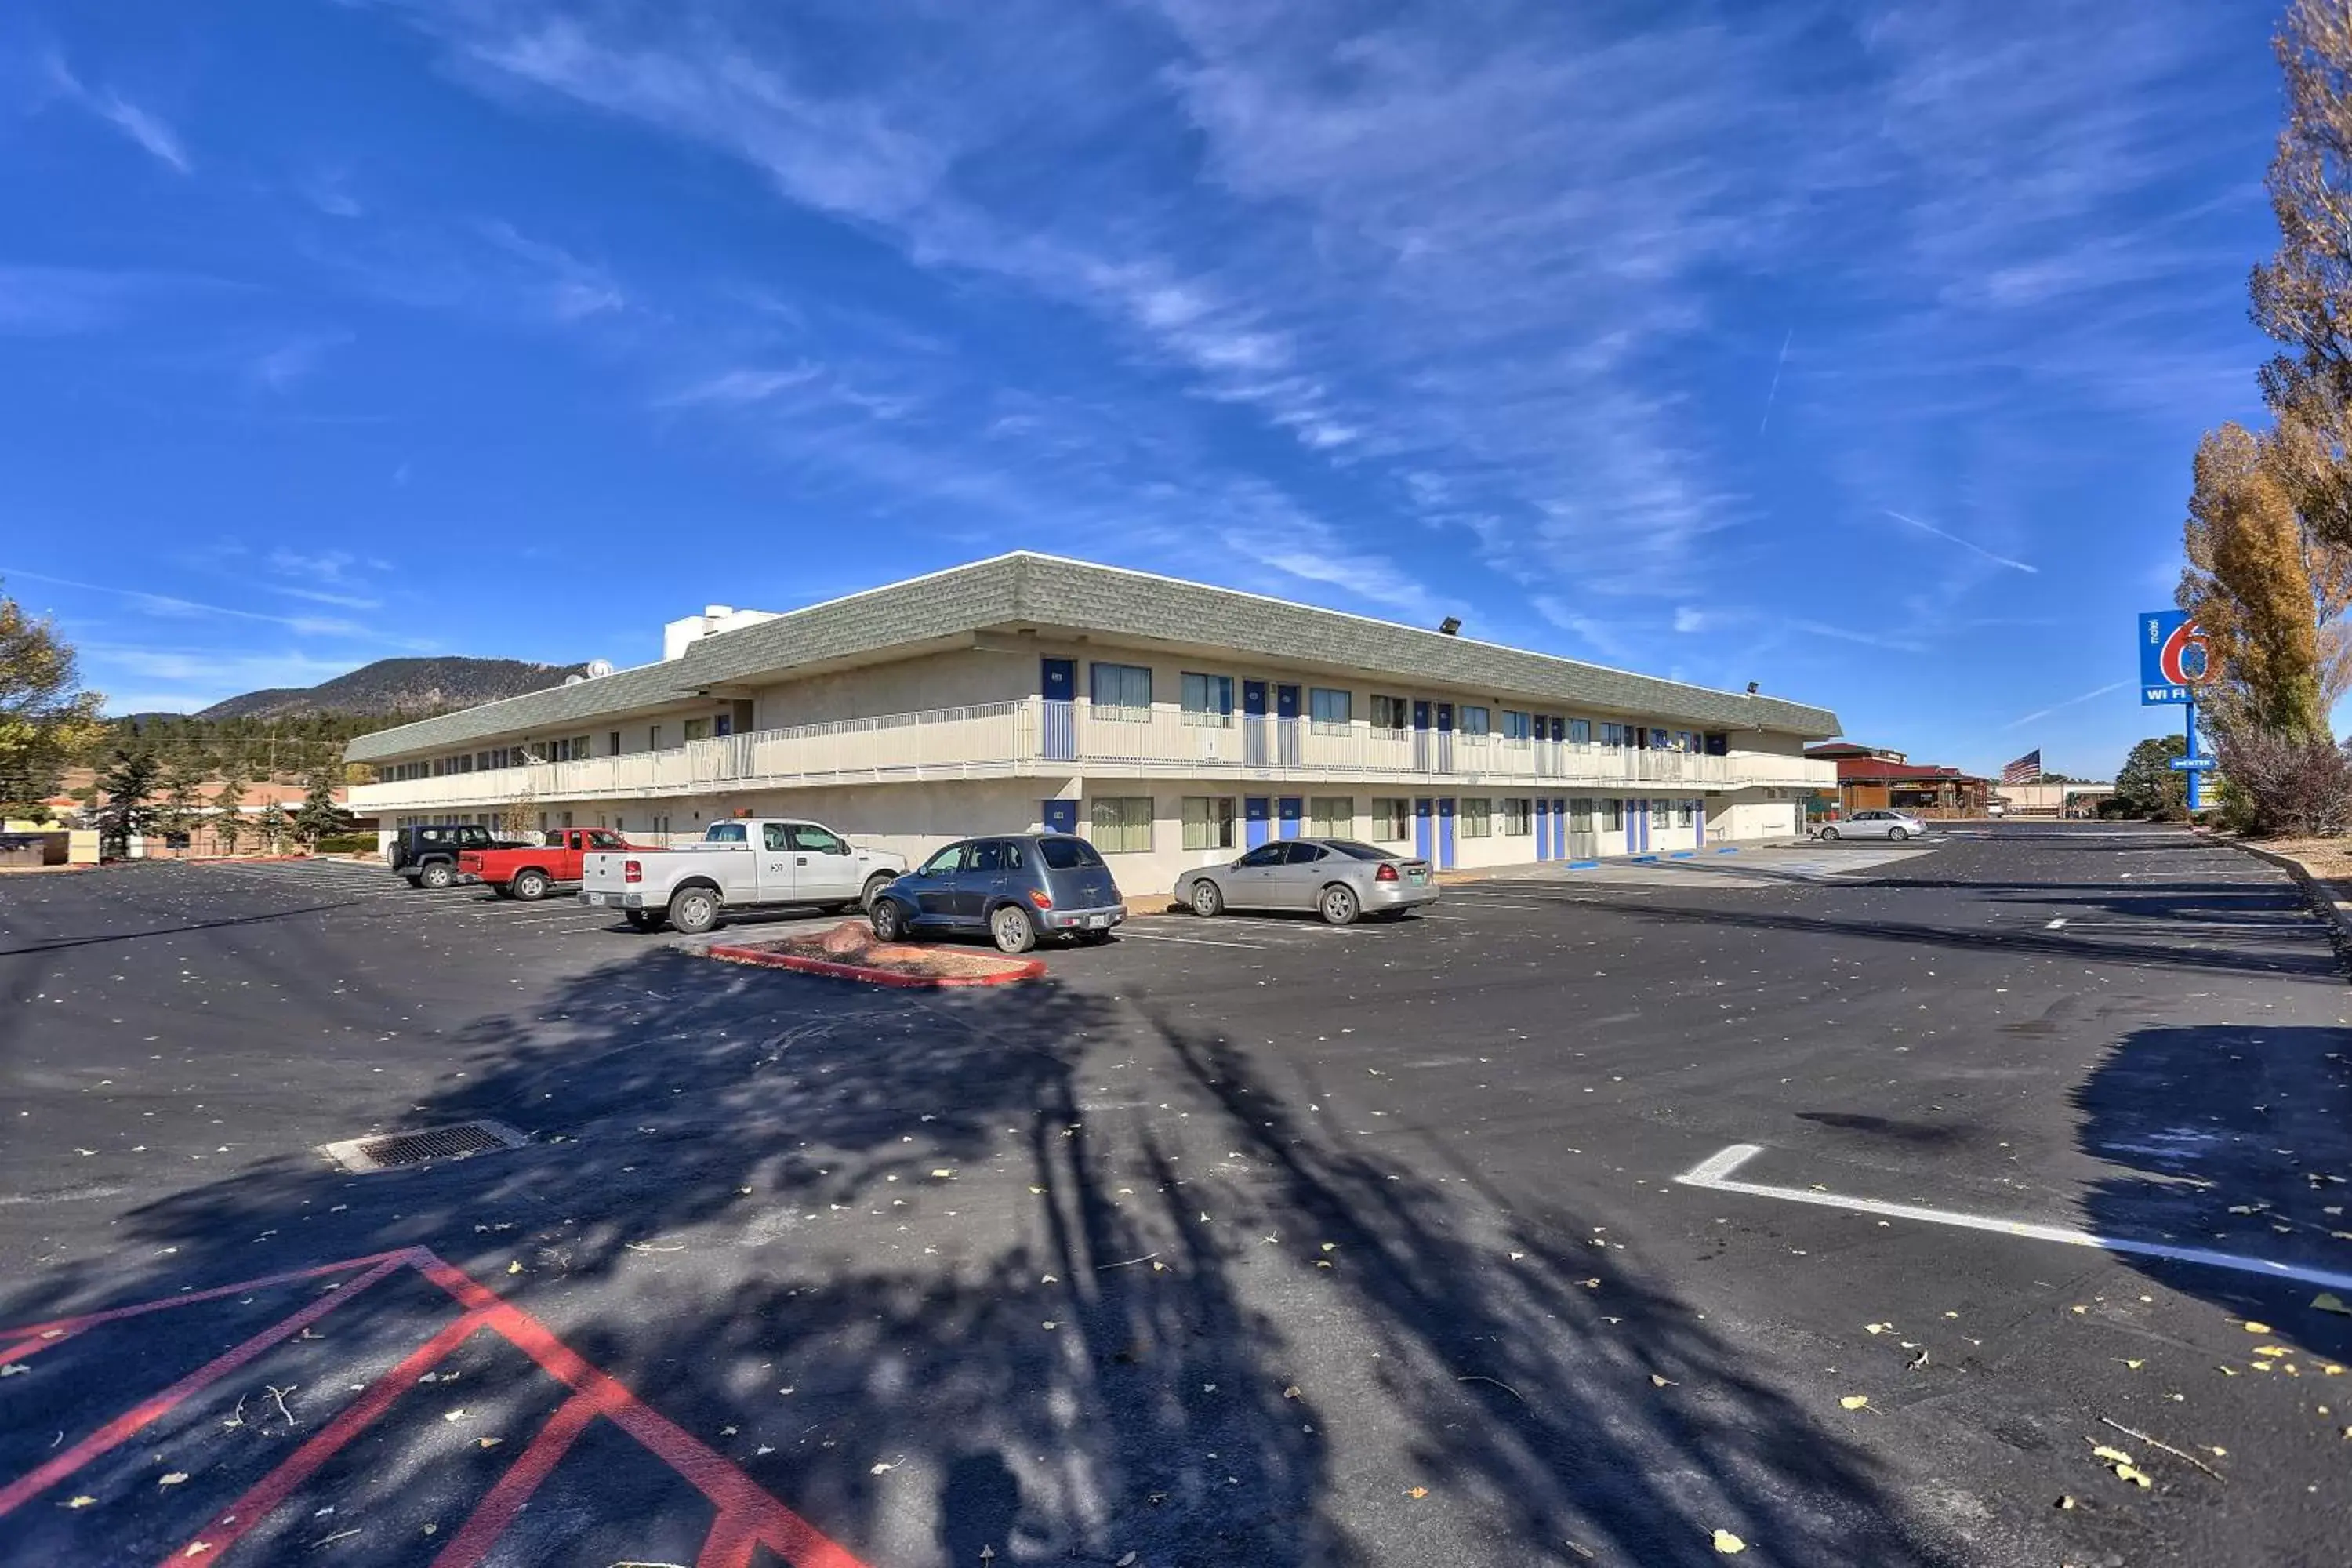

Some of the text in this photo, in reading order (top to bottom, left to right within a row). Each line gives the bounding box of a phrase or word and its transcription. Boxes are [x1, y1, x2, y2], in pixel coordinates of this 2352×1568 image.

[2160, 618, 2223, 685] 6
[2147, 689, 2167, 700] WI
[2172, 688, 2185, 699] FI
